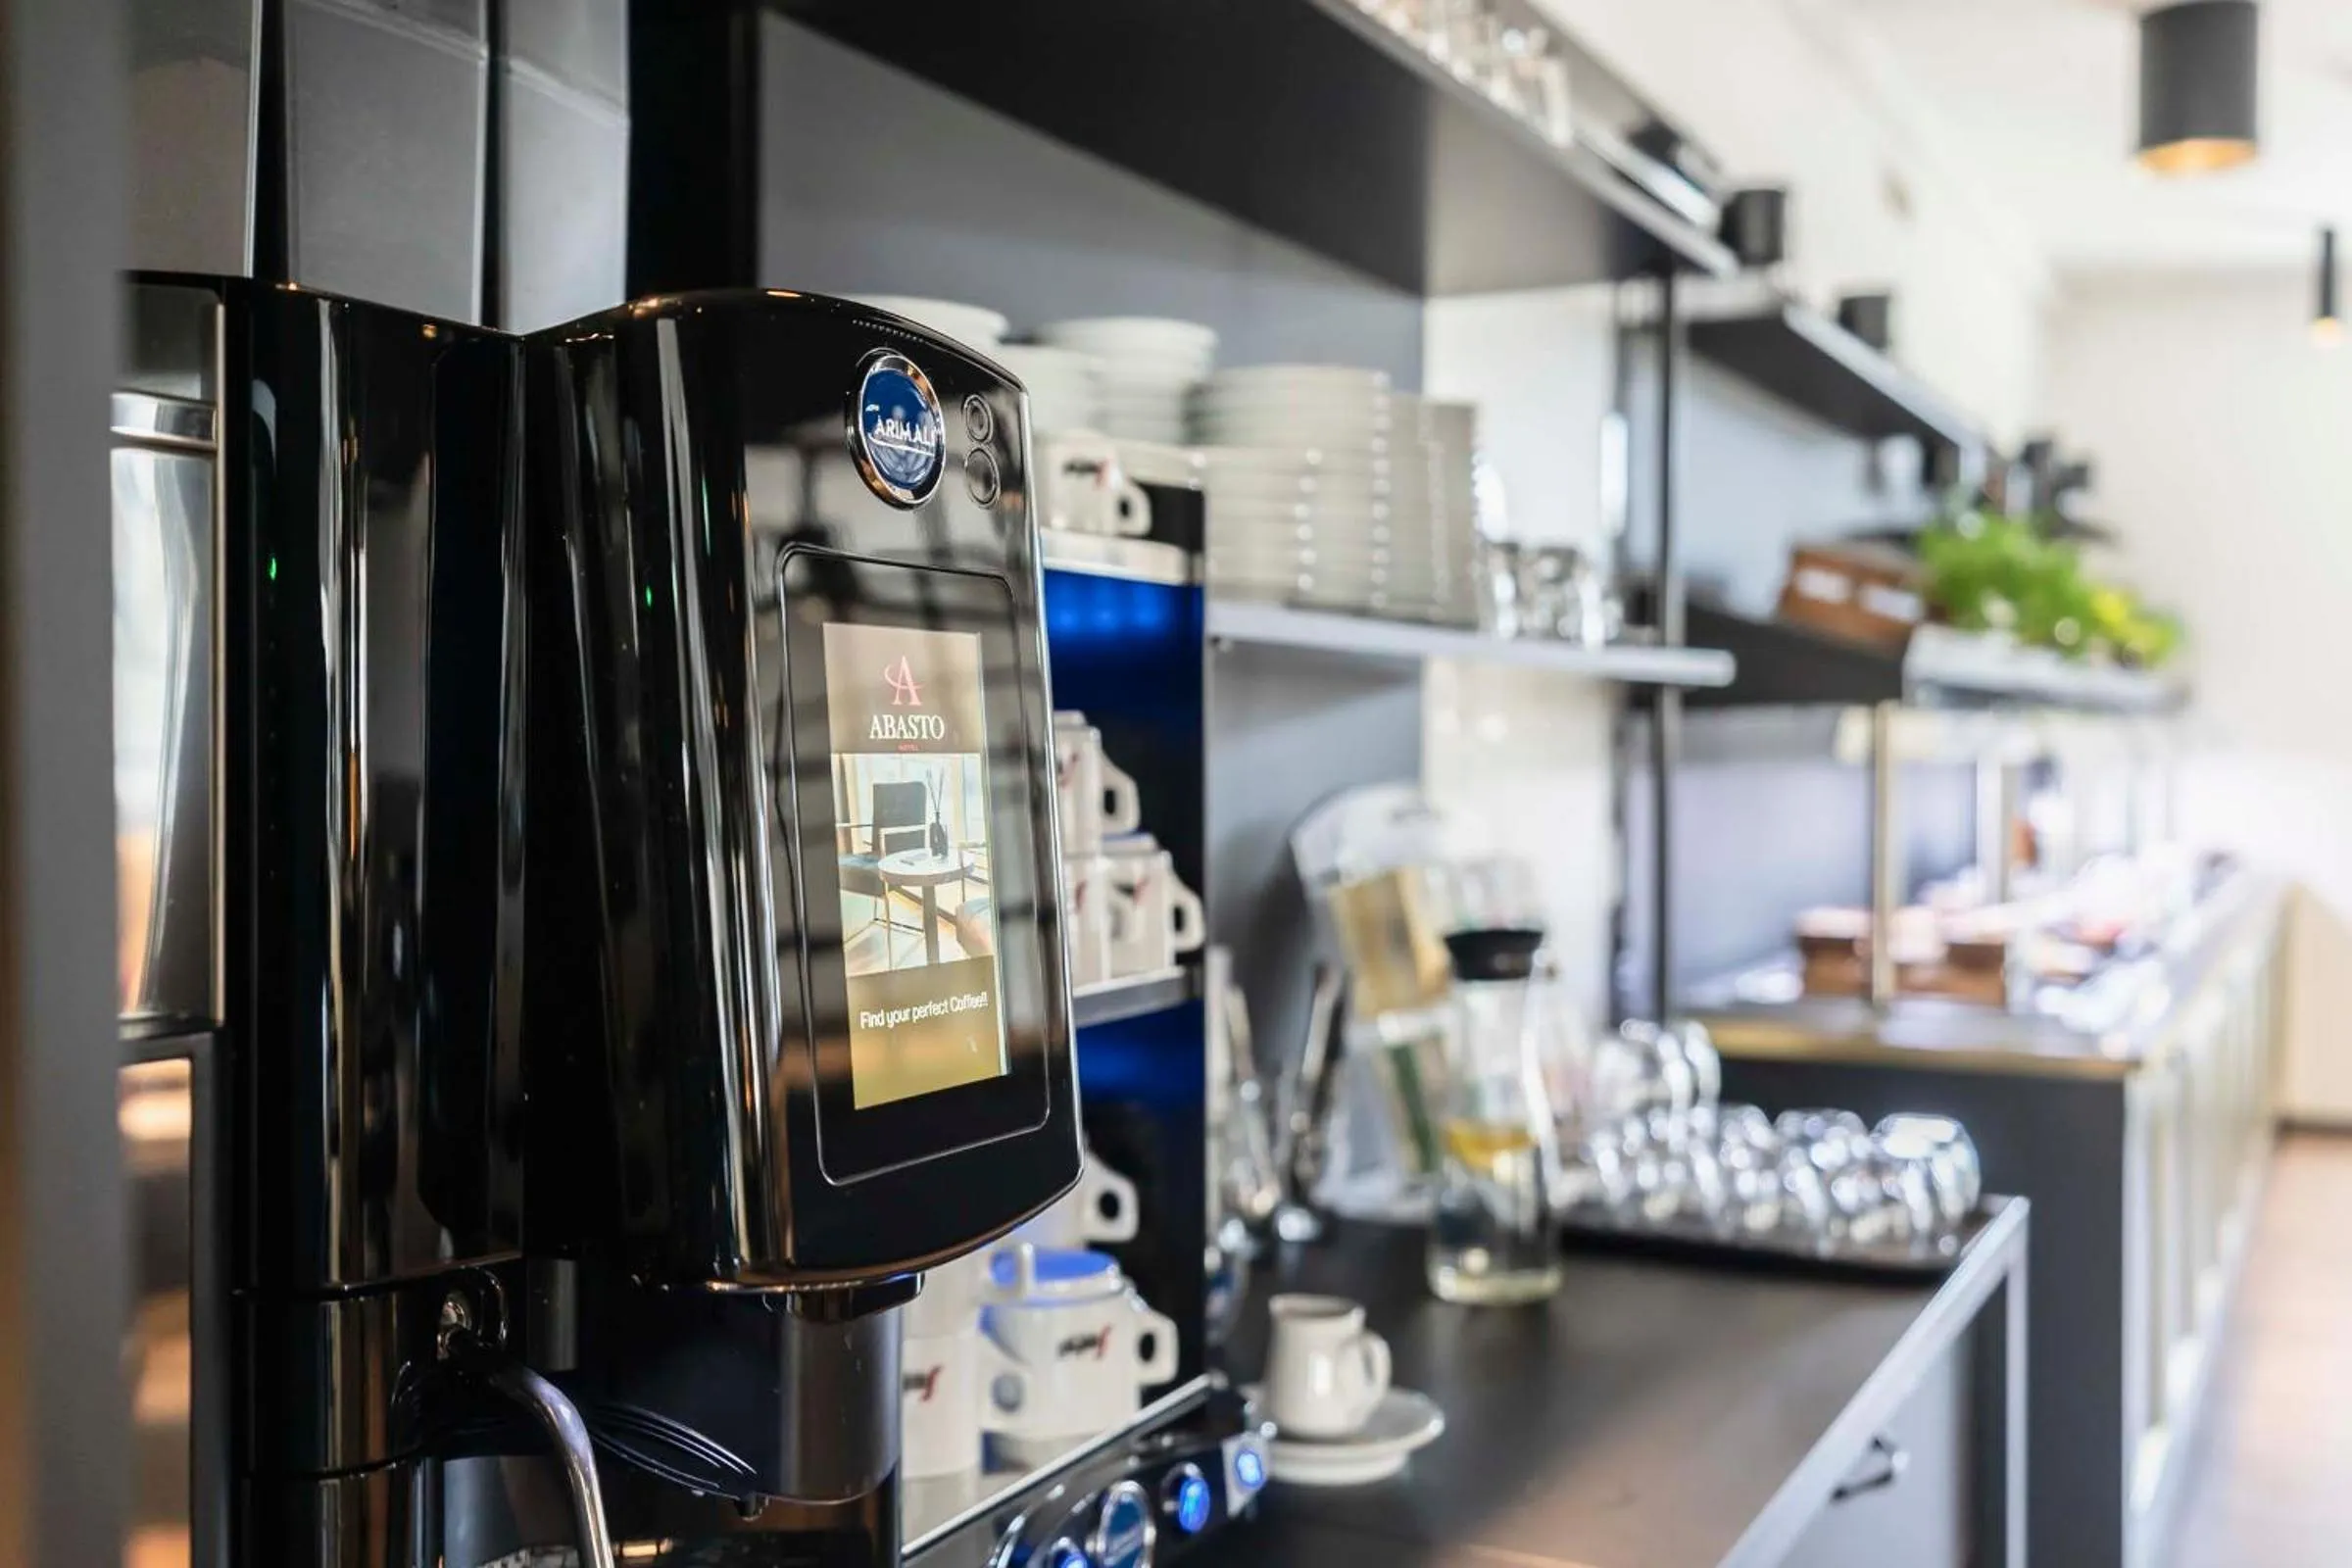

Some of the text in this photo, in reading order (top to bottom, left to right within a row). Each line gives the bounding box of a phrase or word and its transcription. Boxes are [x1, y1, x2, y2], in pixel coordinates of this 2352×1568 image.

[869, 713, 945, 740] ABASTO
[859, 1009, 885, 1029] Find
[886, 1007, 910, 1028] your
[911, 1001, 949, 1023] perfect
